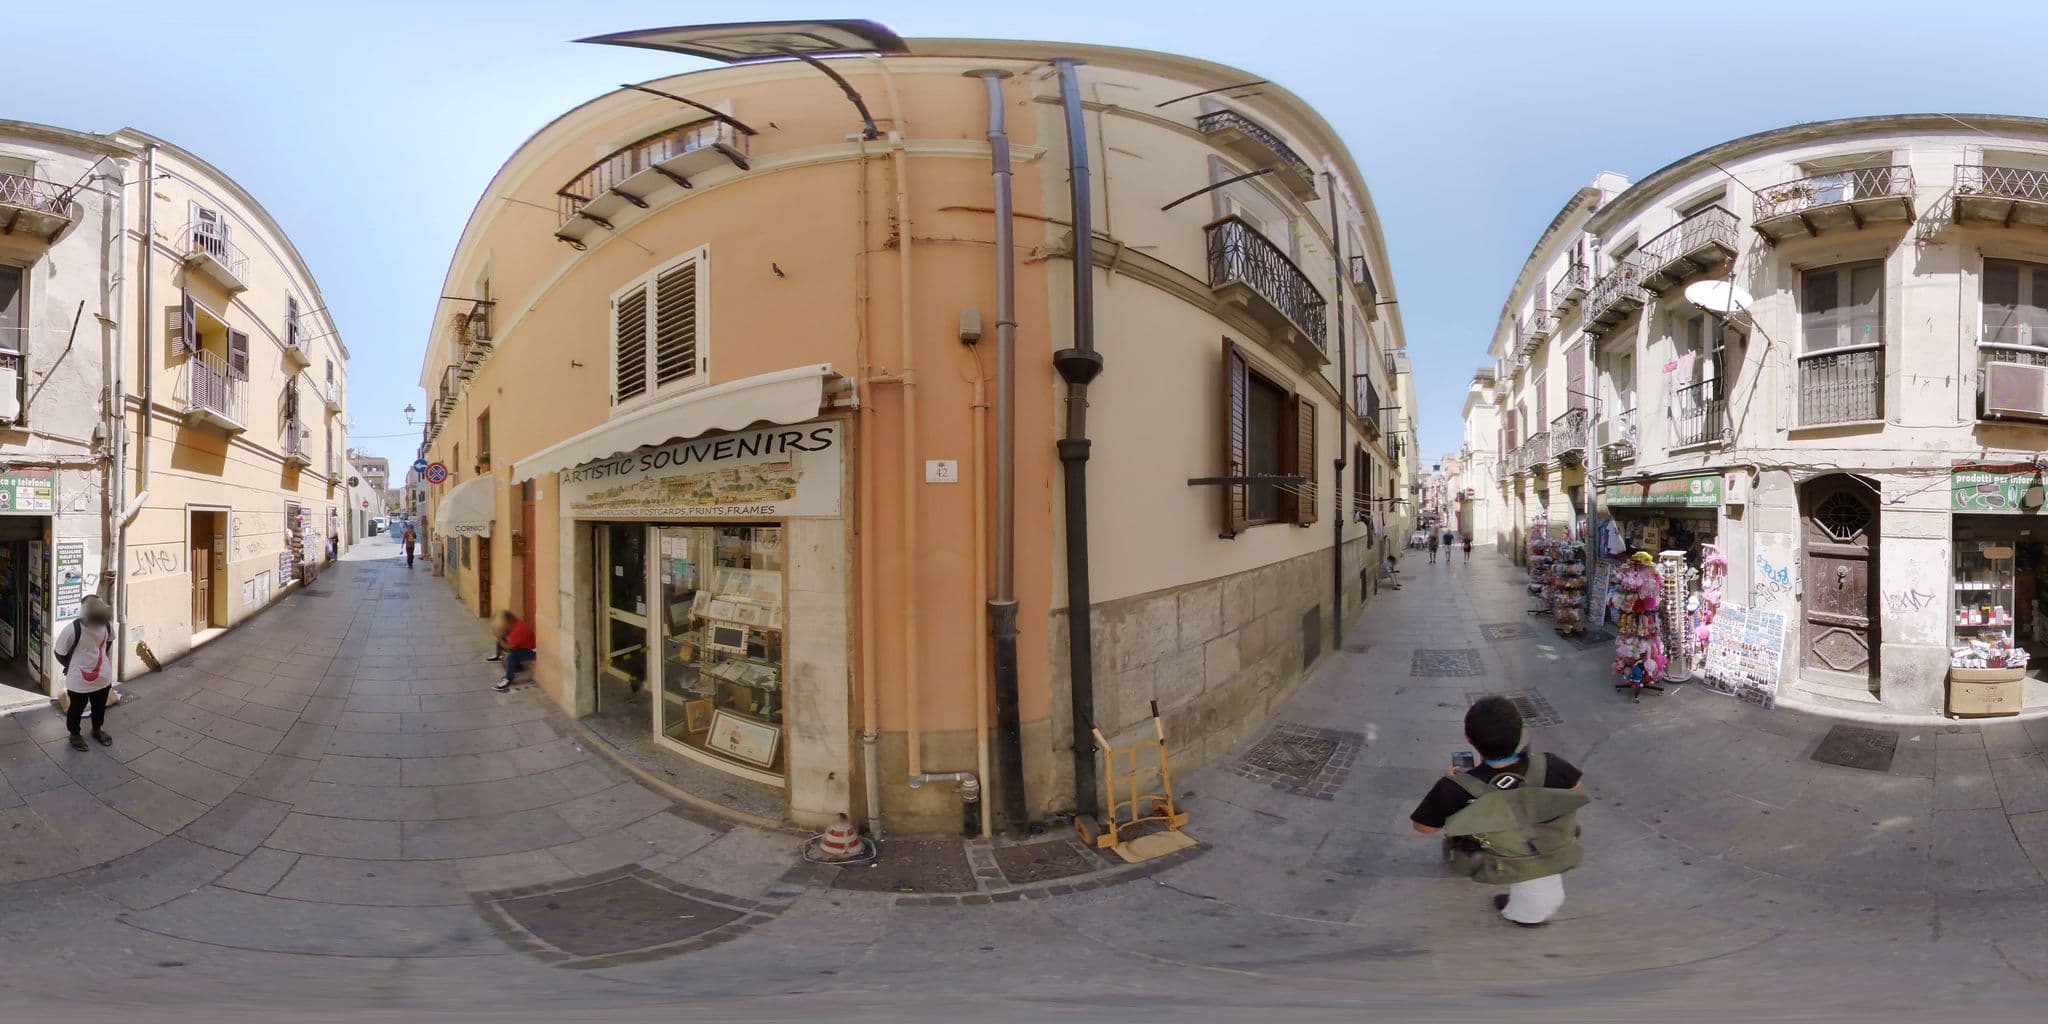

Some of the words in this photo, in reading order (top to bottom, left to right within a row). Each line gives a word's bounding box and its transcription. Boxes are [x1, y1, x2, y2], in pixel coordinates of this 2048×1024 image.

[562, 458, 635, 485] ARTISTIC
[640, 428, 833, 471] SOUVENIRS
[936, 468, 948, 478] 42
[17, 478, 51, 487] telefonia
[1956, 473, 1992, 484] prodotti
[1994, 476, 2008, 484] per
[727, 505, 775, 515] FRAMES
